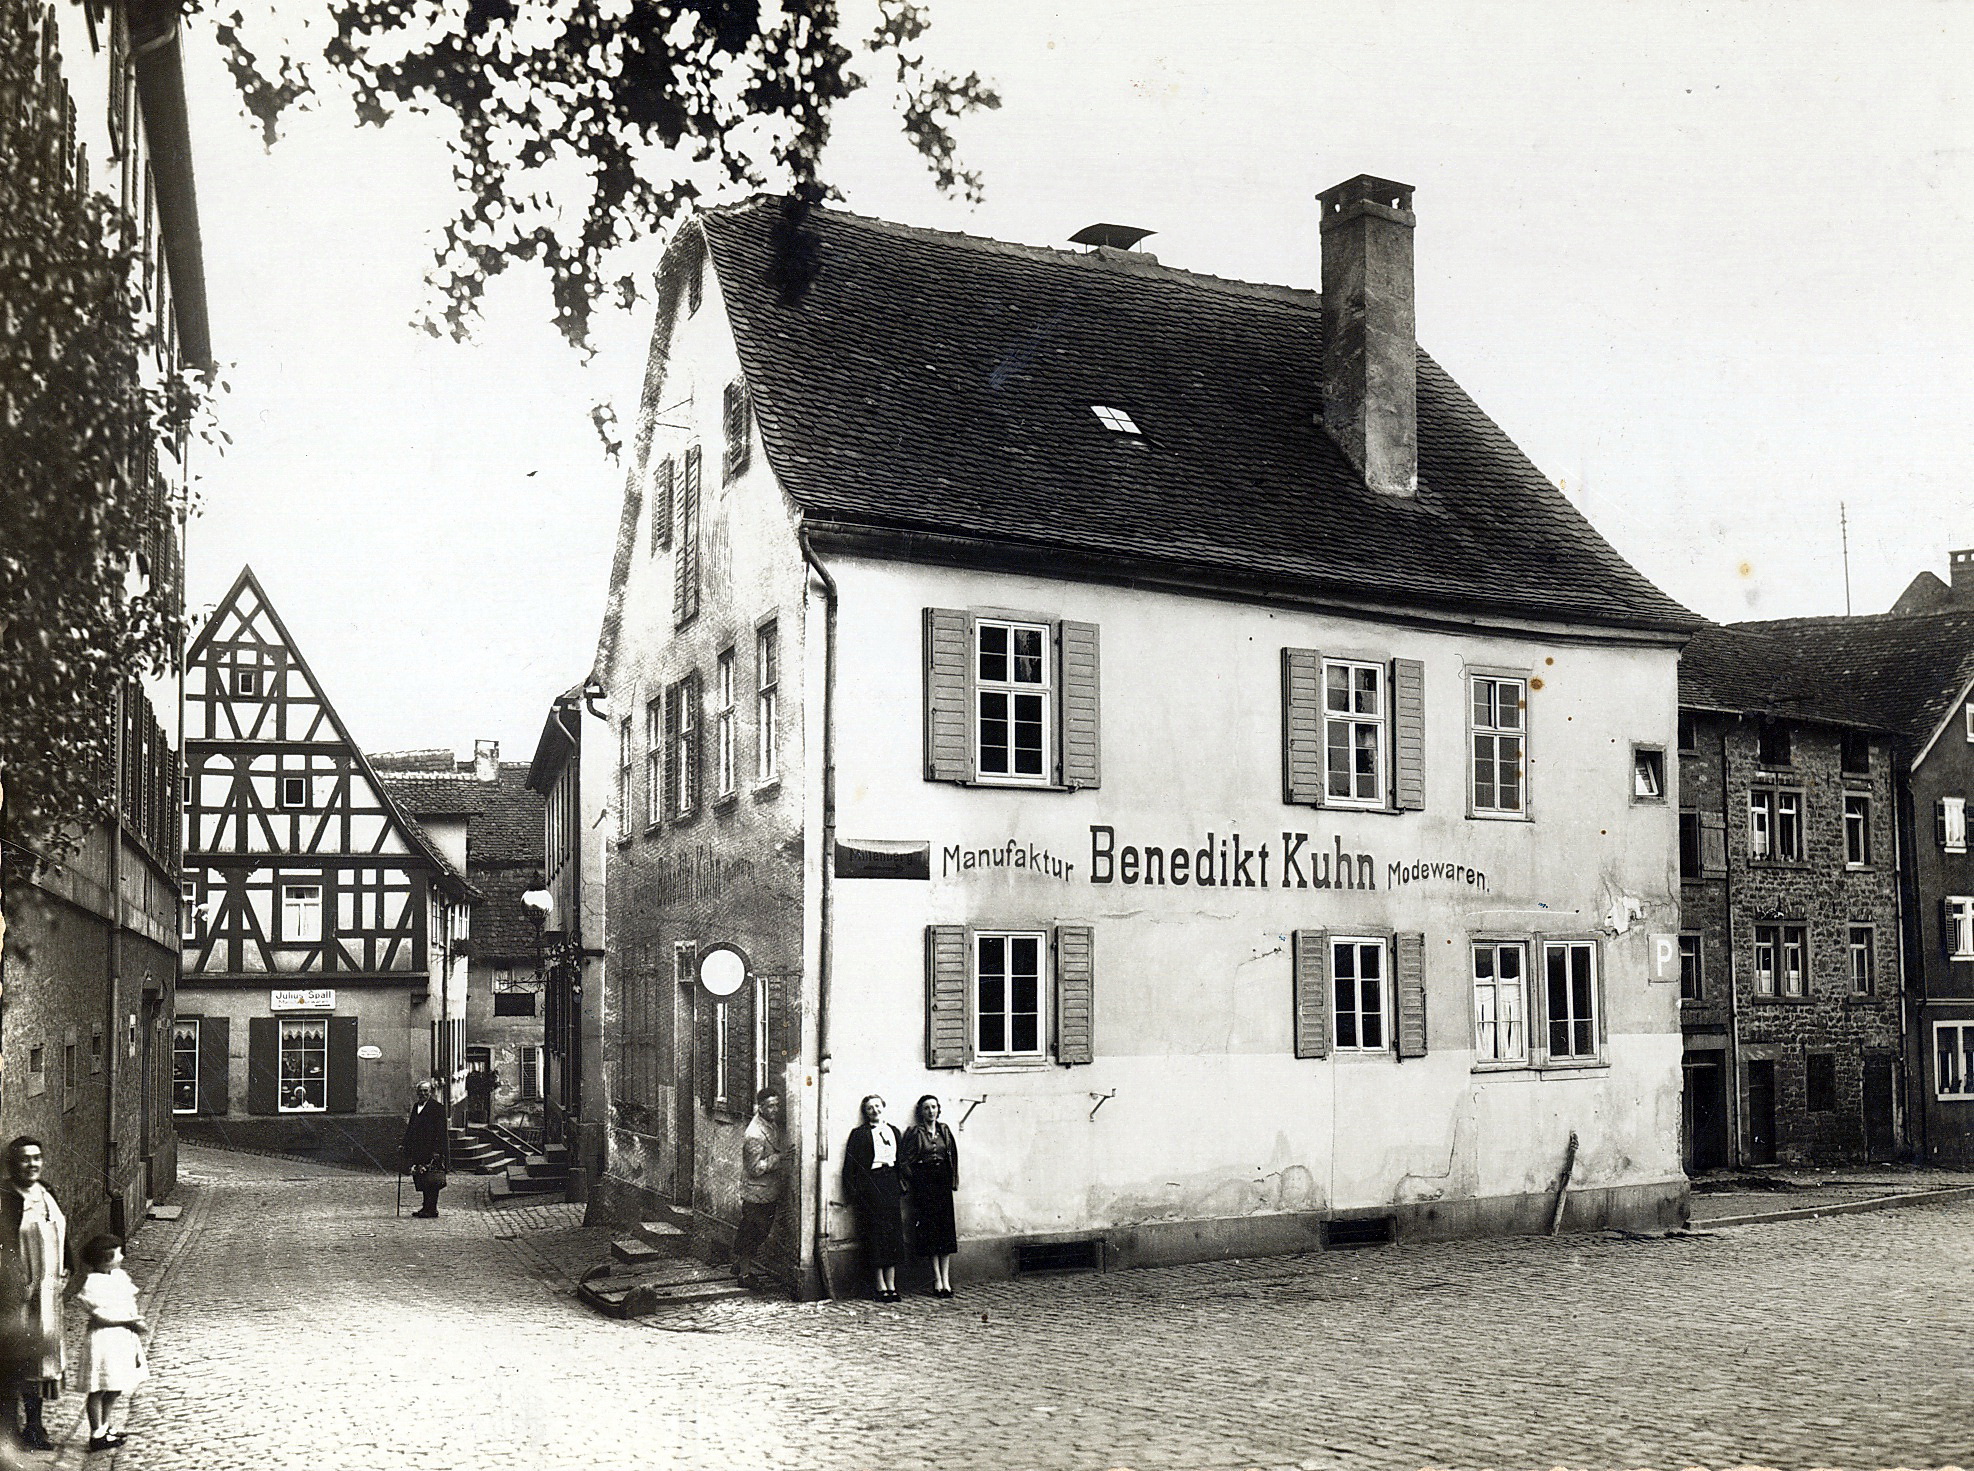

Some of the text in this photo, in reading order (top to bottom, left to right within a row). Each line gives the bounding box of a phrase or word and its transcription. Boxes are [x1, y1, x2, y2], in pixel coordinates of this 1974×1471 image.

[943, 825, 1490, 893] Manufaktur Benedikt Kuhn Modewaren.
[1657, 939, 1672, 977] P
[275, 991, 304, 1000] Julius
